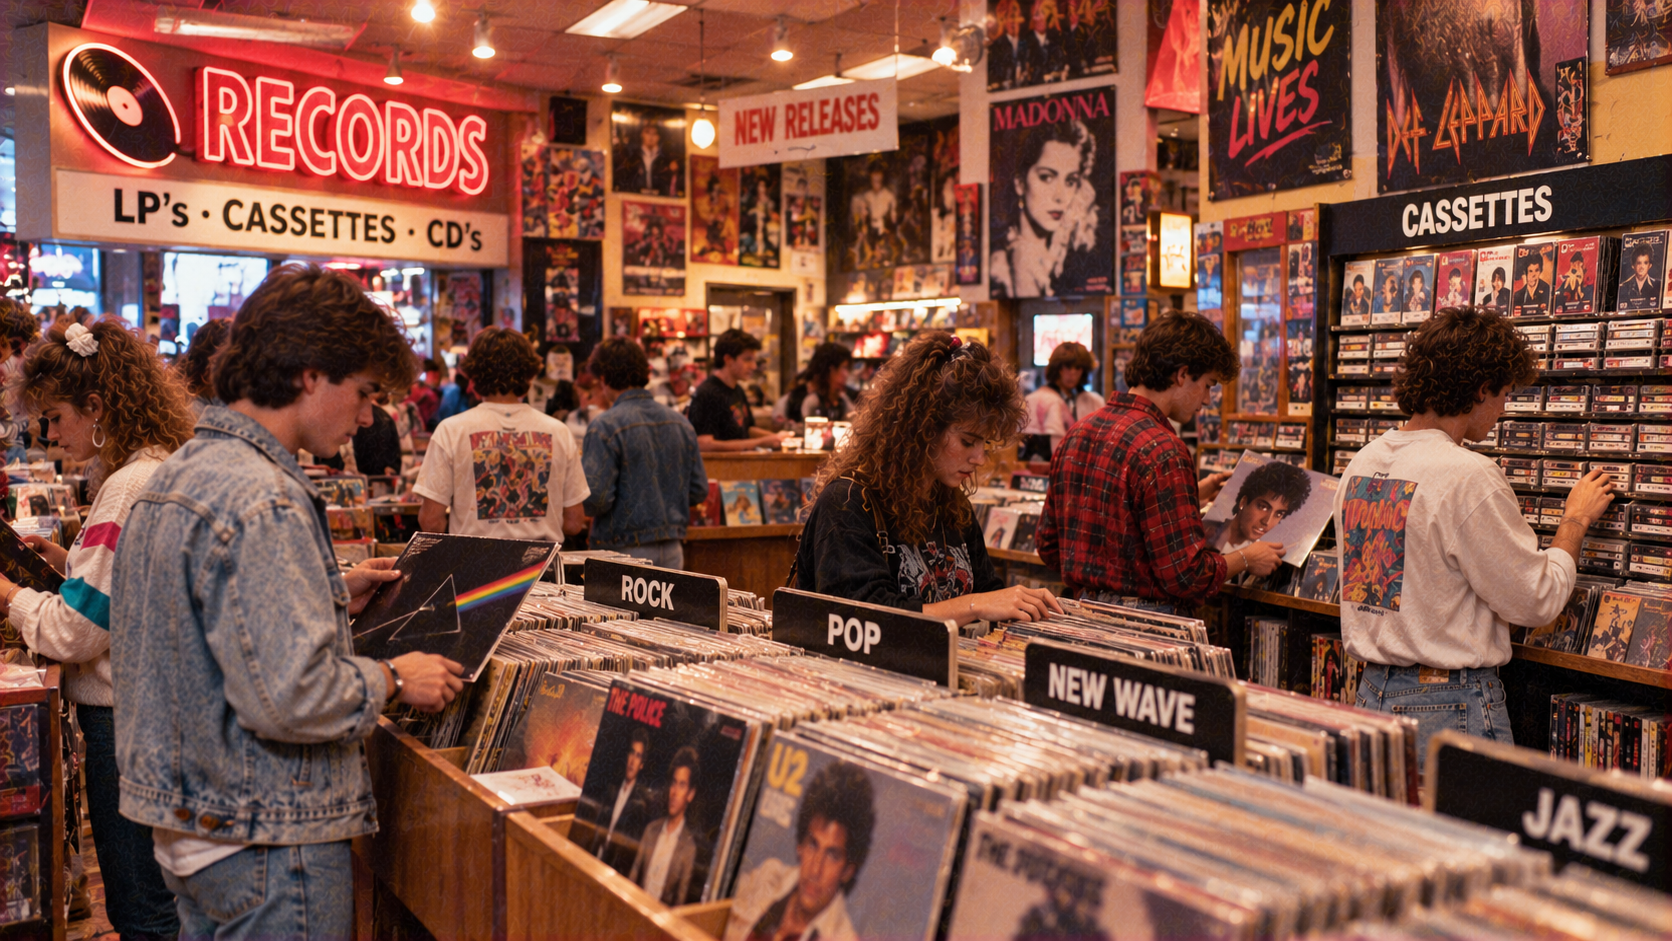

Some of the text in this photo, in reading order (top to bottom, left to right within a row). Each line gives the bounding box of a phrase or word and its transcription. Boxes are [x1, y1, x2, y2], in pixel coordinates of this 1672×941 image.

[1216, 0, 1335, 101] MUSIC
[202, 66, 490, 196] RECORDS
[734, 92, 880, 146] NEW RELEASES
[993, 92, 1111, 132] MADONNA
[1228, 60, 1320, 160] LIVES
[1386, 68, 1546, 180] DEF LEPPARD
[113, 188, 482, 252] LP's CASSETTES CD's
[1402, 185, 1553, 238] CASSETTES
[621, 574, 675, 611] ROCK
[827, 613, 881, 655] POP
[607, 686, 667, 728] THE POLICE
[1048, 662, 1196, 735] NEW WAVE
[767, 742, 809, 798] U2
[1522, 787, 1653, 873] JAZZ
